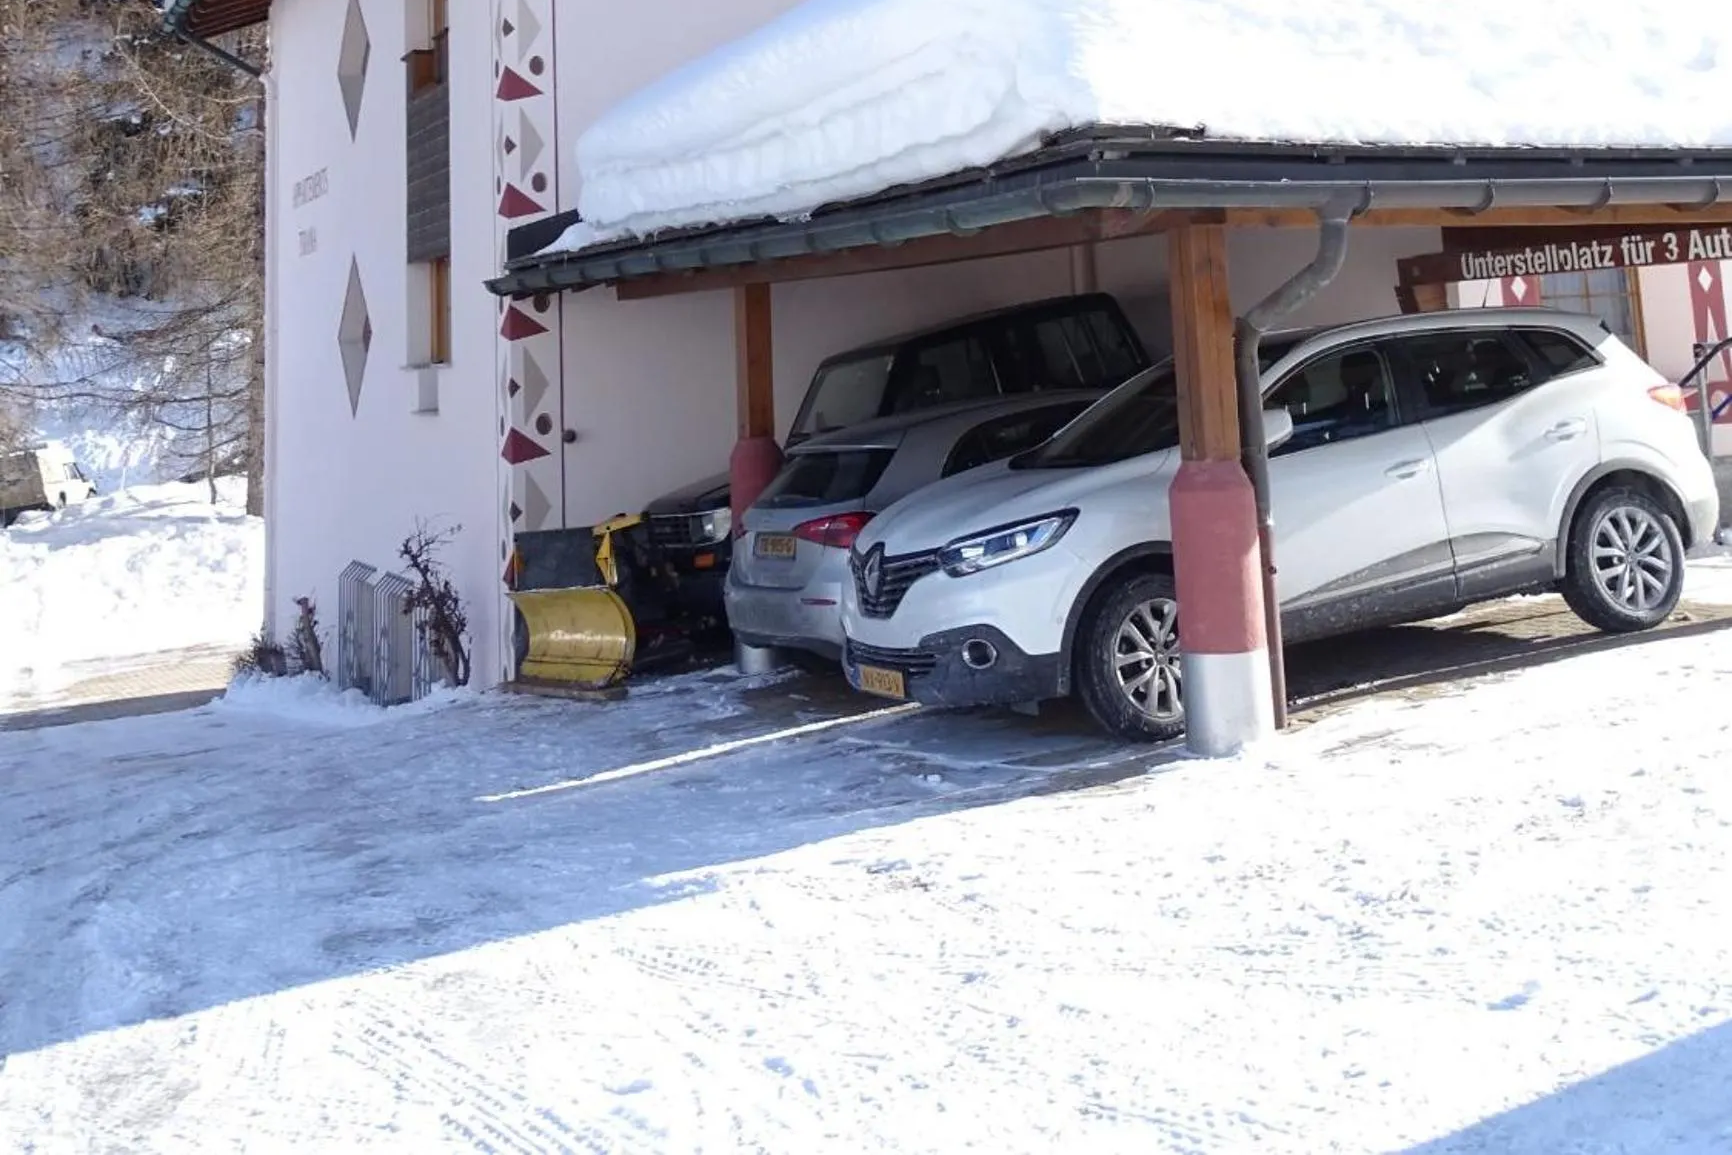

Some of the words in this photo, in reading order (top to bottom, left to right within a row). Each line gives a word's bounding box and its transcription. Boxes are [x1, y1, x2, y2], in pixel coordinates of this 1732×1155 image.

[1461, 240, 1616, 279] Unterstellplatz
[1620, 235, 1656, 266] für
[1662, 232, 1679, 261] 3
